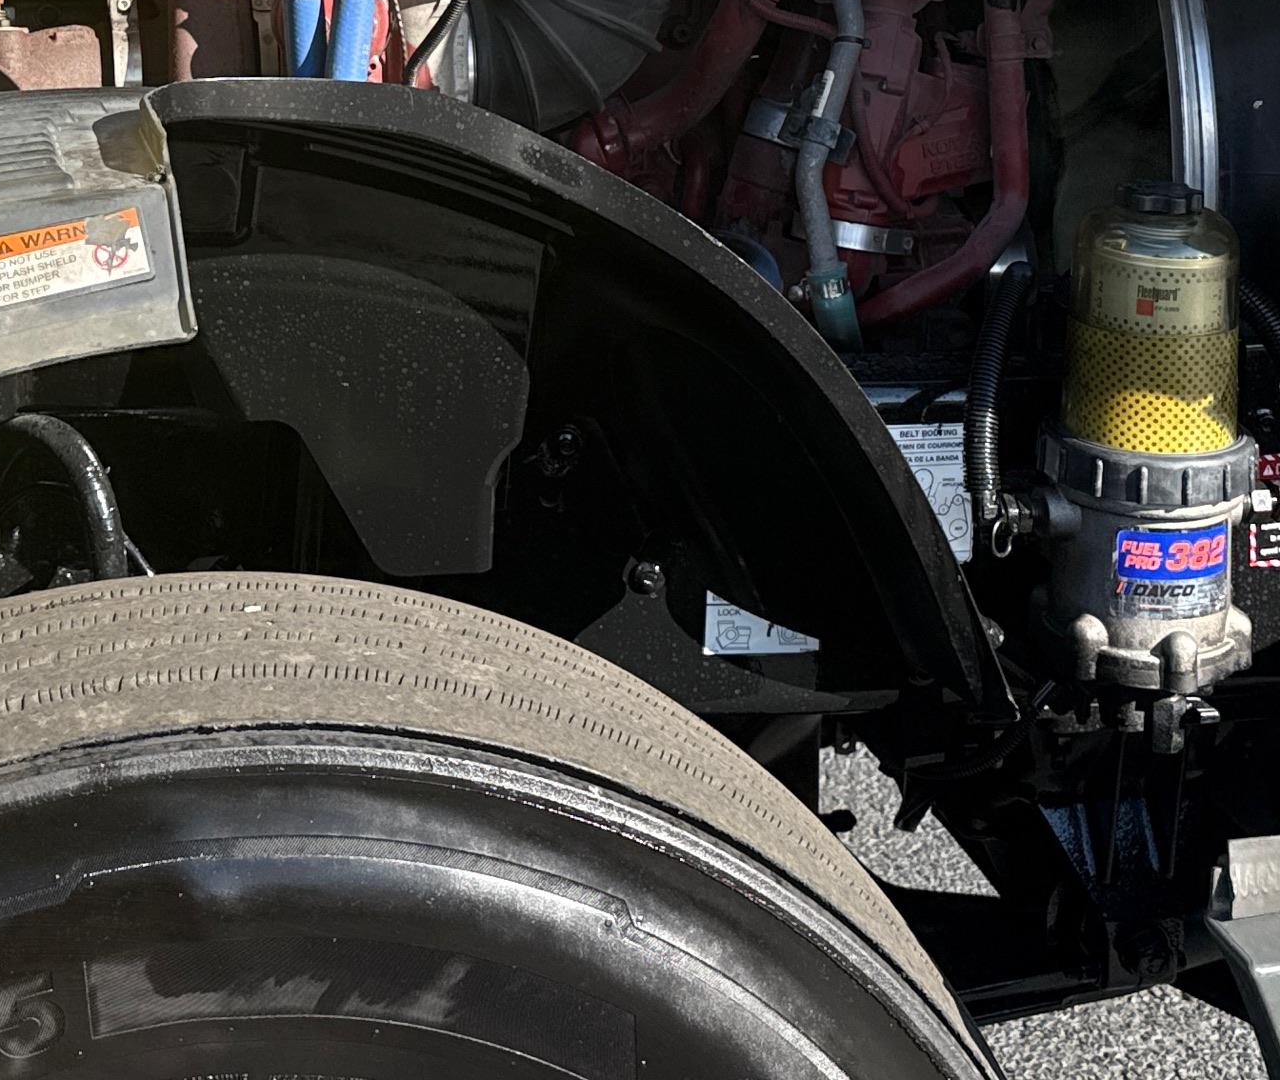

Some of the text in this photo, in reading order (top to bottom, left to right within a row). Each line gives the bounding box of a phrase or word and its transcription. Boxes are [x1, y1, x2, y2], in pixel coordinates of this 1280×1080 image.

[20, 225, 86, 248] WARN
[9, 255, 31, 267] NOT
[35, 249, 57, 260] USE
[38, 254, 76, 271] SHIELD
[13, 270, 61, 289] BUMPER
[23, 284, 50, 298] STEP
[1137, 284, 1177, 302] Fleetguard
[899, 430, 920, 438] BELT
[1121, 540, 1163, 556] FUEL
[1165, 534, 1225, 572] 382
[1124, 555, 1163, 570] PRO
[1133, 584, 1195, 597] DAYCO
[718, 608, 741, 616] LOCK
